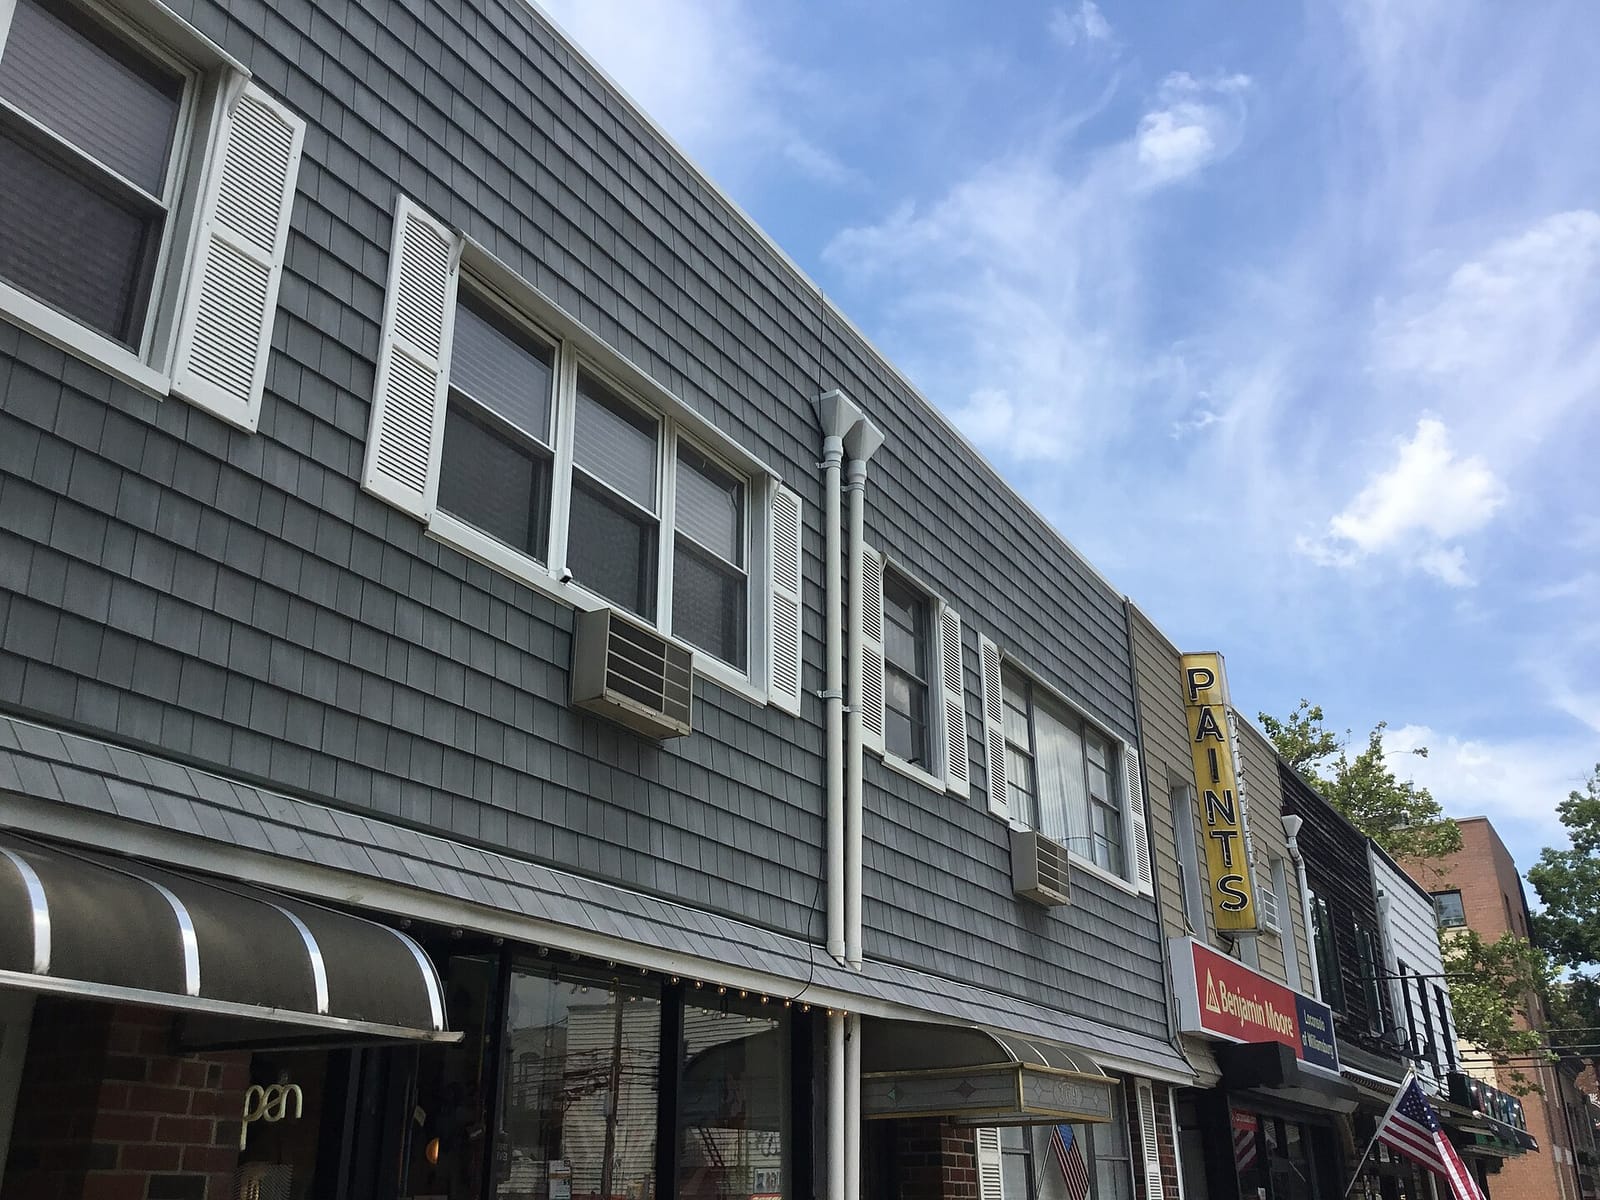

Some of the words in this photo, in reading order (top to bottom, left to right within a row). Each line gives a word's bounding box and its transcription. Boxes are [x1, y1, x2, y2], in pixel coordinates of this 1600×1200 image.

[1186, 667, 1249, 911] PAINTS
[1219, 980, 1265, 1027] Benjamin
[1265, 1001, 1294, 1038] Moore
